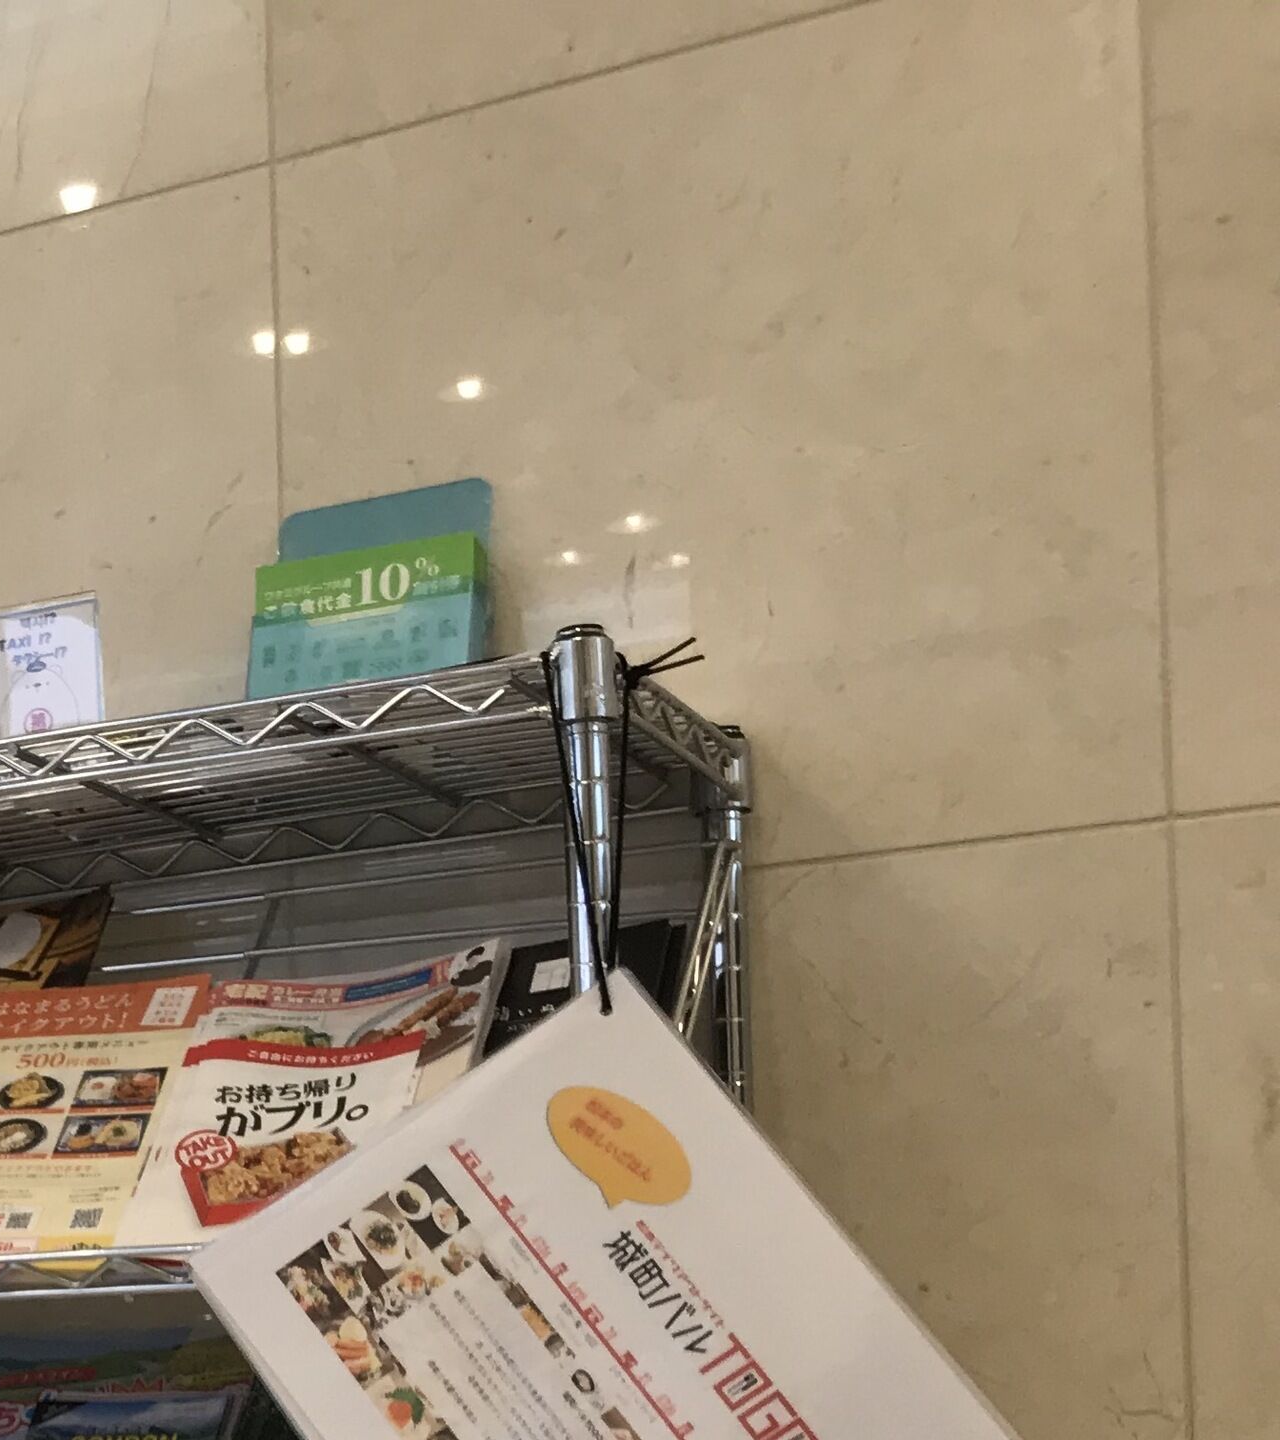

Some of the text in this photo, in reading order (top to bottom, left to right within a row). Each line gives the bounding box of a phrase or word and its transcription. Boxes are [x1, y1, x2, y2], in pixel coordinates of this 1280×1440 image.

[215, 1072, 357, 1104] お持ち帰り
[602, 1230, 715, 1355] 城町バル
